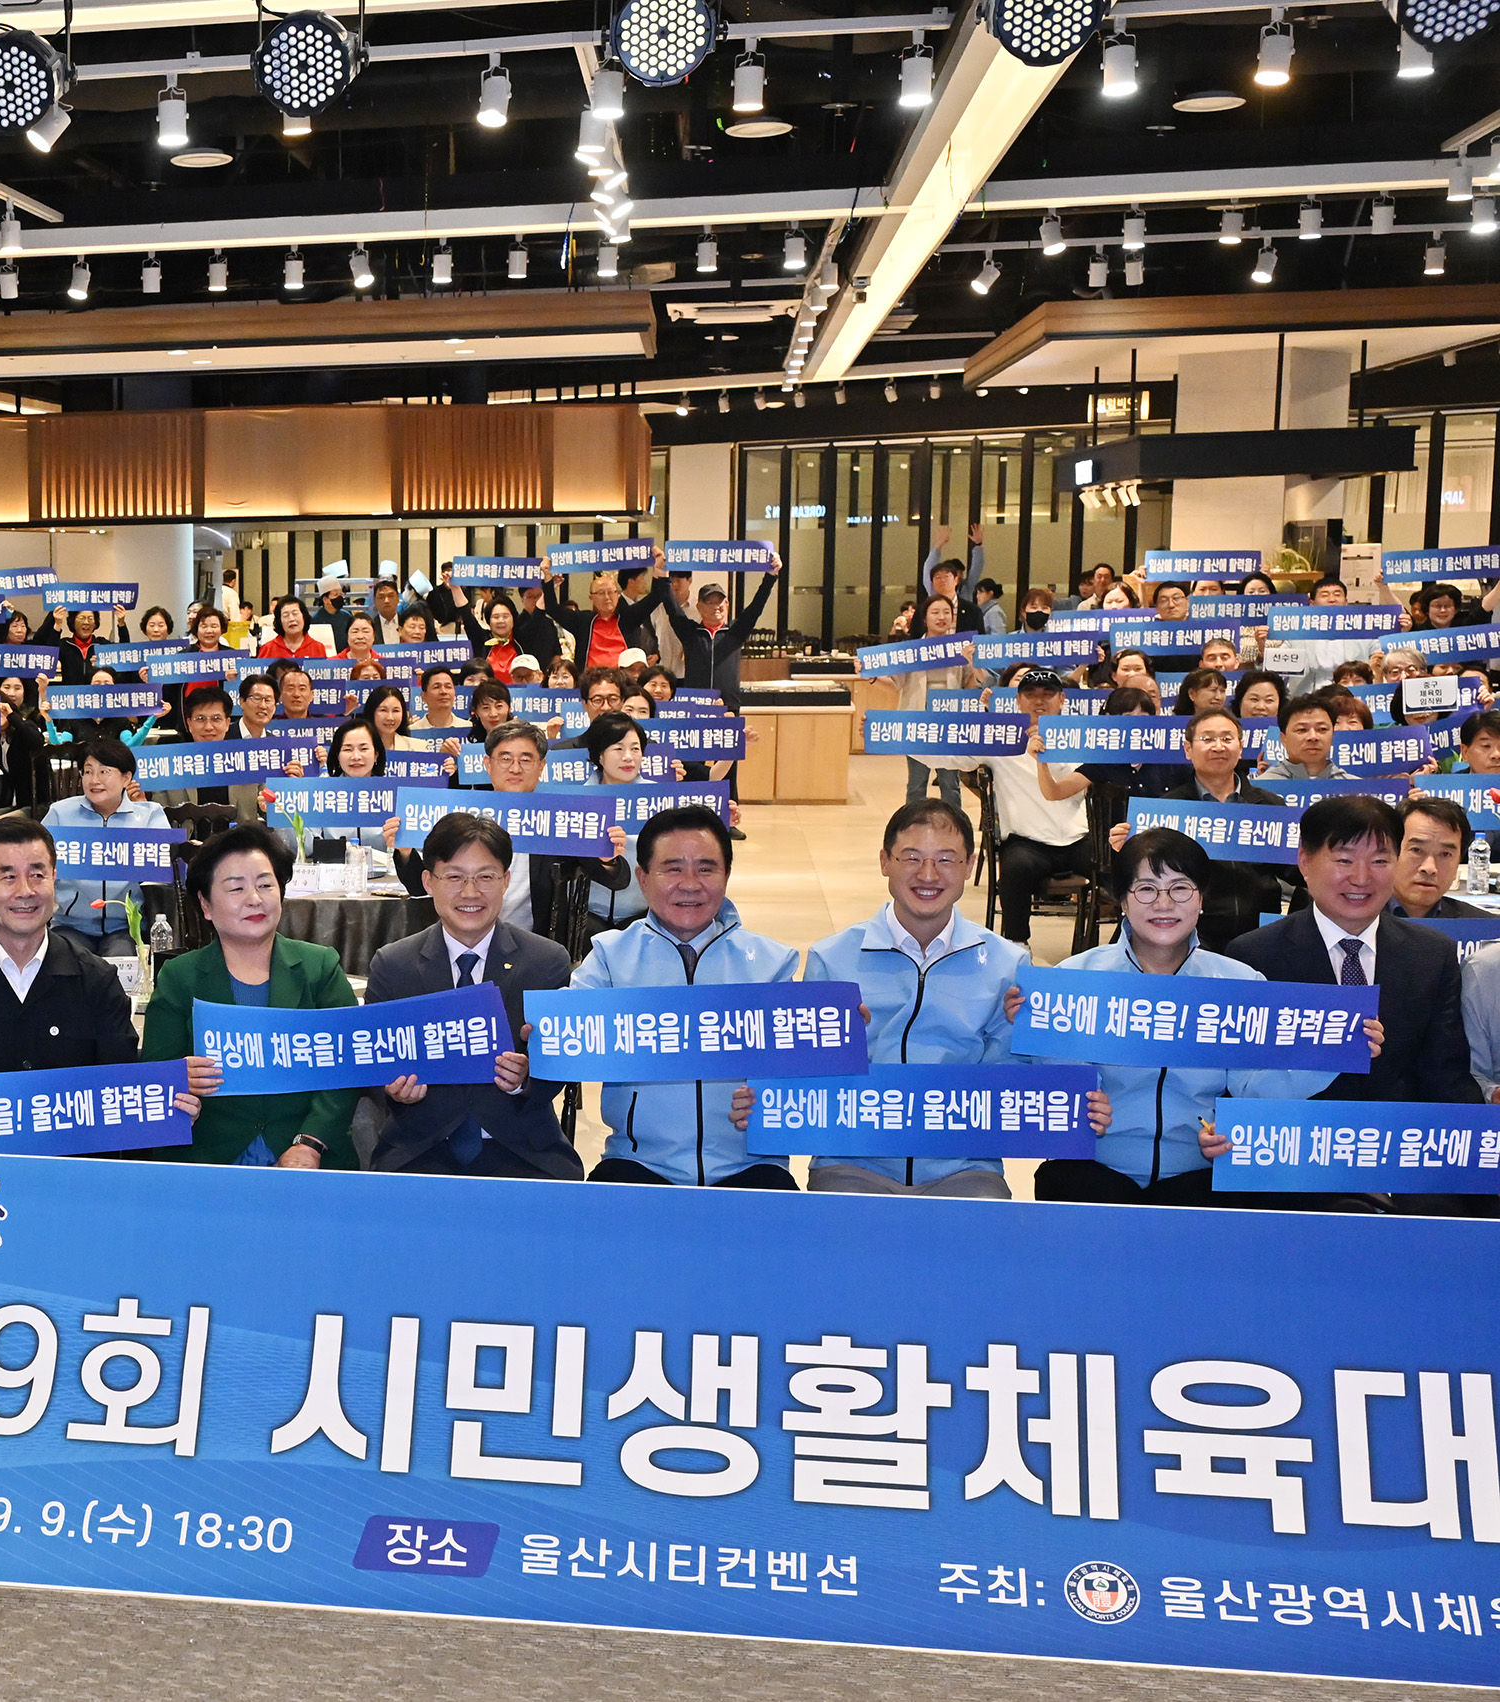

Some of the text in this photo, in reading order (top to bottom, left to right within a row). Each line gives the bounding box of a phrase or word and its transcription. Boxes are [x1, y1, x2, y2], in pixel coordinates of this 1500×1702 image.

[668, 548, 773, 563] 일상에 체육을! 울산에 활력을!
[1149, 558, 1256, 573] 일상에 체육을! 울산에 활력을!
[1273, 614, 1396, 631] 일상에 체육을! 울산에 활력을!
[4, 653, 26, 668] 울산에
[28, 654, 57, 670] 활력을!
[978, 640, 1093, 659] 일상에 체육을! 울산에 활력을!
[1273, 652, 1299, 663] 선수단
[1420, 689, 1443, 698] 체육회
[1422, 681, 1438, 689] 중구
[51, 692, 158, 710] 일상에 체육을! 울산에 활력을!
[870, 722, 1022, 744] 일상에 체육을! 울산에 활력을!
[137, 749, 286, 778] 일상에 체육을! 울산에 활력을!
[1338, 739, 1424, 765] 울산에 활력을!
[312, 792, 392, 812] 체육을! 울산에
[555, 812, 606, 838] 활력을!
[539, 1008, 850, 1055] 일상에 체육을! 울산에 활력을!
[1030, 993, 1362, 1044] 일상에 체육을! 울산에 활력을!
[204, 1018, 497, 1069] 일상에 체육을! 울산에 활력을!
[32, 1091, 94, 1131] 울산에
[102, 1085, 179, 1124] 활력을!
[762, 1089, 1080, 1131] 일상에 체육을! 울산에 활력을!
[1230, 1124, 1470, 1169] 일상에 체육을! 울산에
[271, 1314, 1500, 1544] 시민생활체육대
[40, 1499, 153, 1548] 9.(수)
[174, 1511, 293, 1553] 18:30
[385, 1524, 468, 1567] 장소
[520, 1534, 858, 1596] 울산시티컨벤션
[938, 1562, 1045, 1608] 주최:
[1160, 1576, 1500, 1636] 울산광역시체
[1068, 1592, 1136, 1620] ULSAN SPORTS COUNCIL
